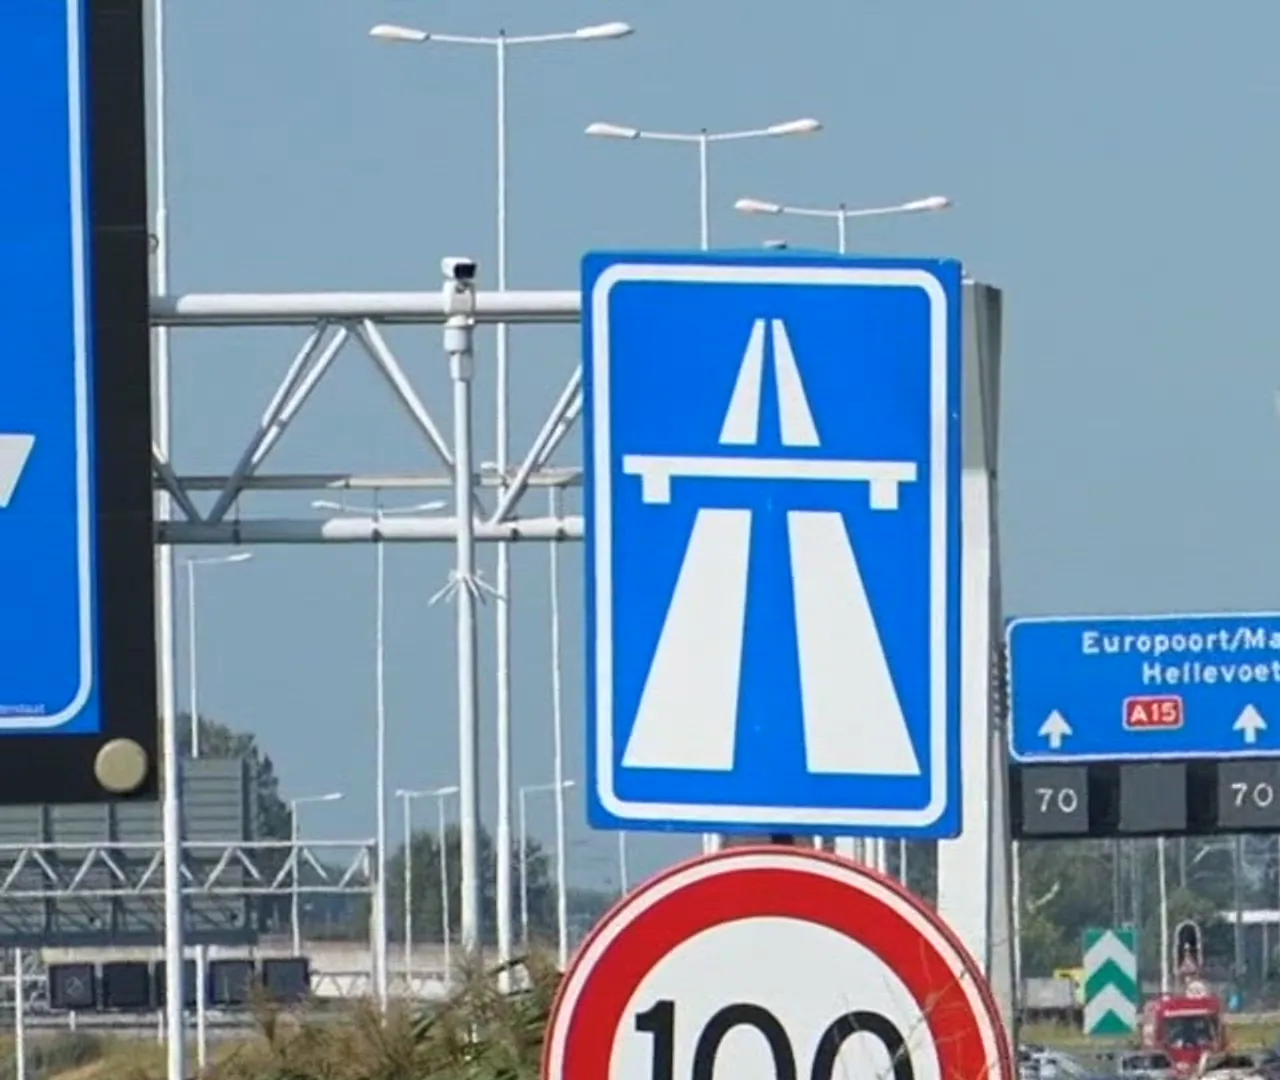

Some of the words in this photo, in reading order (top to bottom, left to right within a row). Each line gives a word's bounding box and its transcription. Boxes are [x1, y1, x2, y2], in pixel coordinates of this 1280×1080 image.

[1129, 702, 1177, 723] A15
[1035, 787, 1077, 813] 70
[1231, 783, 1273, 807] 70
